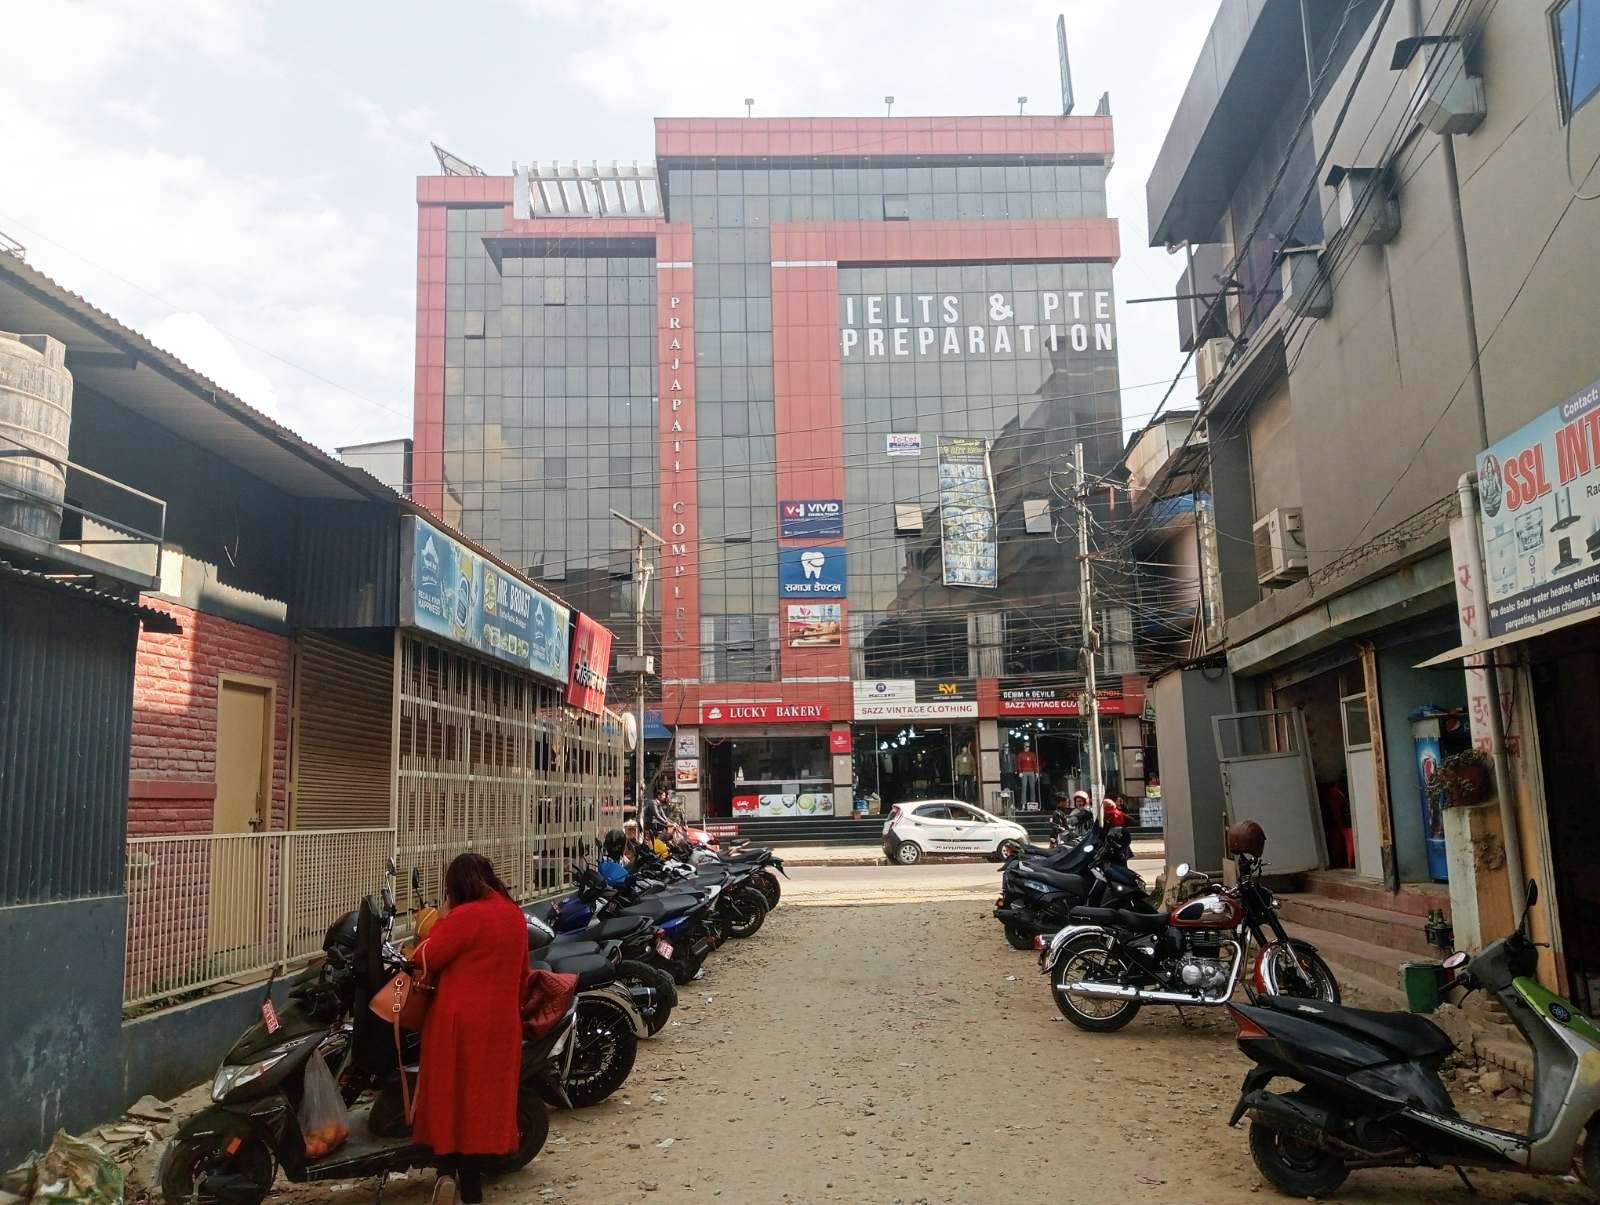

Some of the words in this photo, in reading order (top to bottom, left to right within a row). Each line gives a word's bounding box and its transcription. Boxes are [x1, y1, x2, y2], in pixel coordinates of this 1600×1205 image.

[846, 295, 959, 324] IELTS
[989, 293, 1013, 321] &
[1043, 292, 1110, 320] PTE
[842, 323, 1113, 356] PREPARATION
[669, 297, 683, 473] PRAJAPATI
[1563, 387, 1599, 417] Contact:
[1503, 442, 1551, 512] SSL
[808, 503, 839, 512] VIVID
[672, 501, 687, 643] COMPLEX
[785, 584, 811, 592] समाज
[1516, 598, 1532, 610] Solar
[1550, 583, 1573, 597] heater,
[1573, 573, 1600, 589] electric
[1537, 606, 1561, 620] kitchen
[730, 706, 767, 718] LUCKY
[776, 705, 823, 717] BAKERY
[862, 706, 883, 715] SAZZ
[887, 705, 924, 714] VINTAGE
[927, 705, 973, 713] CLOTHING
